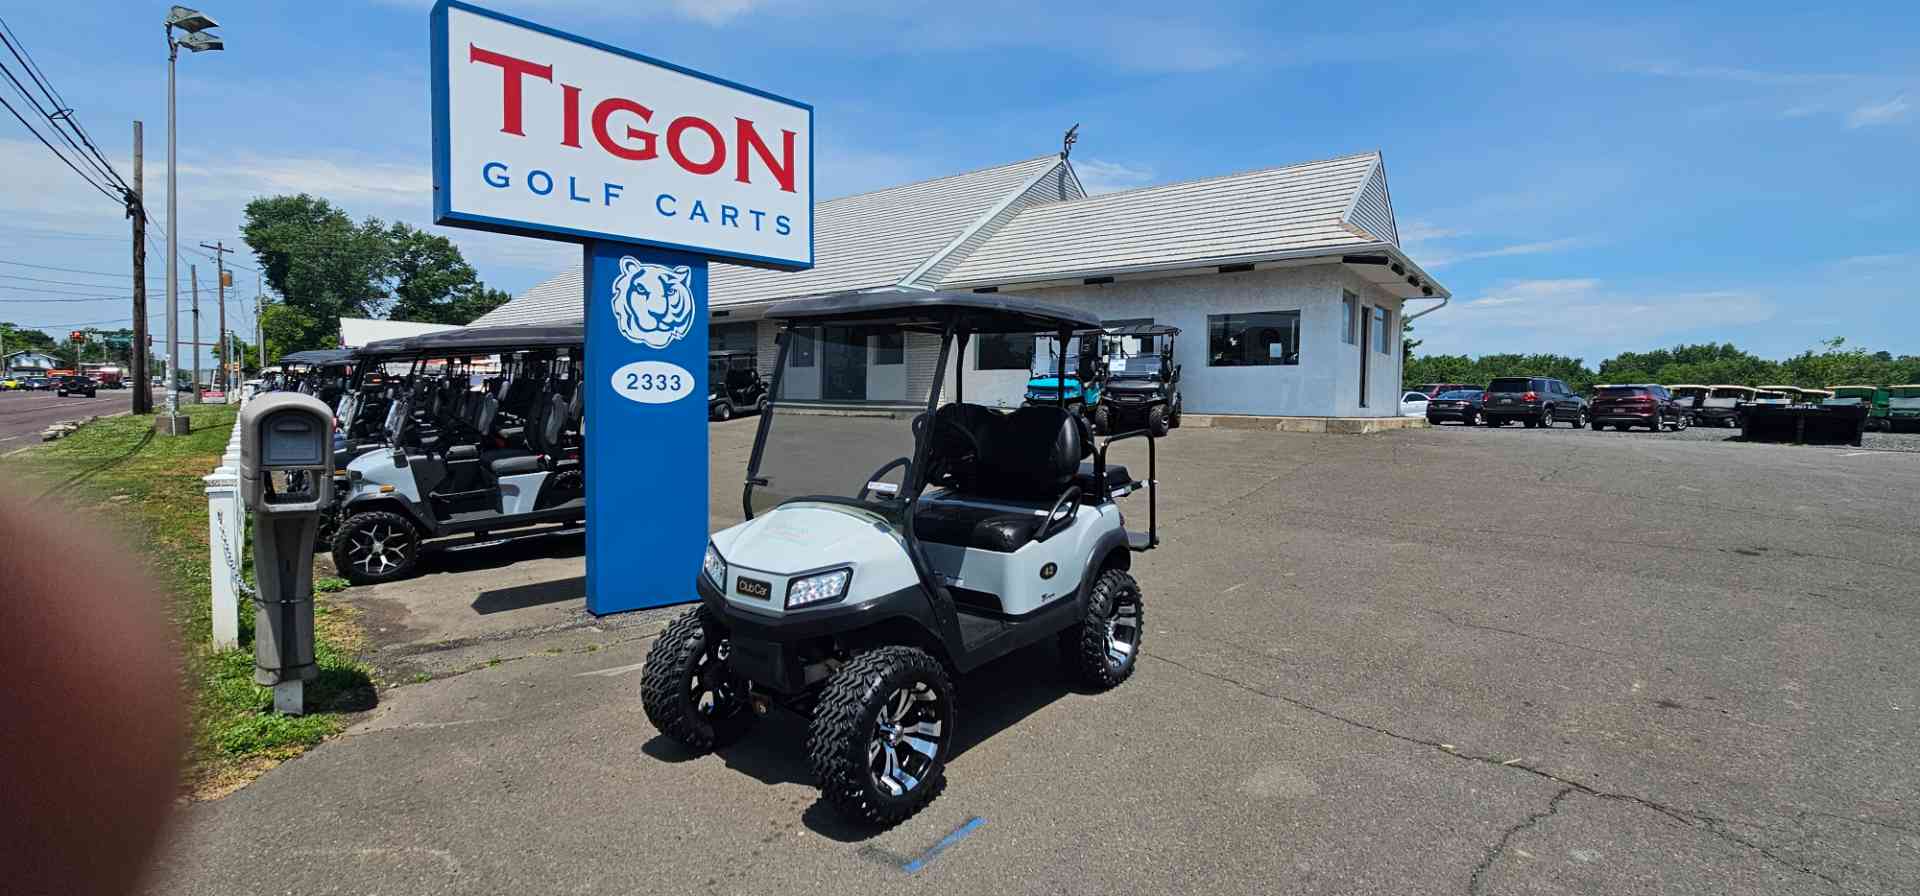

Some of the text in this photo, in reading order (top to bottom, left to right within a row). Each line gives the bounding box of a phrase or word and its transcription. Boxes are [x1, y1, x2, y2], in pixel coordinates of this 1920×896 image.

[470, 42, 797, 193] TIGON
[482, 161, 791, 236] GOLF CARTS
[626, 373, 681, 391] 2333
